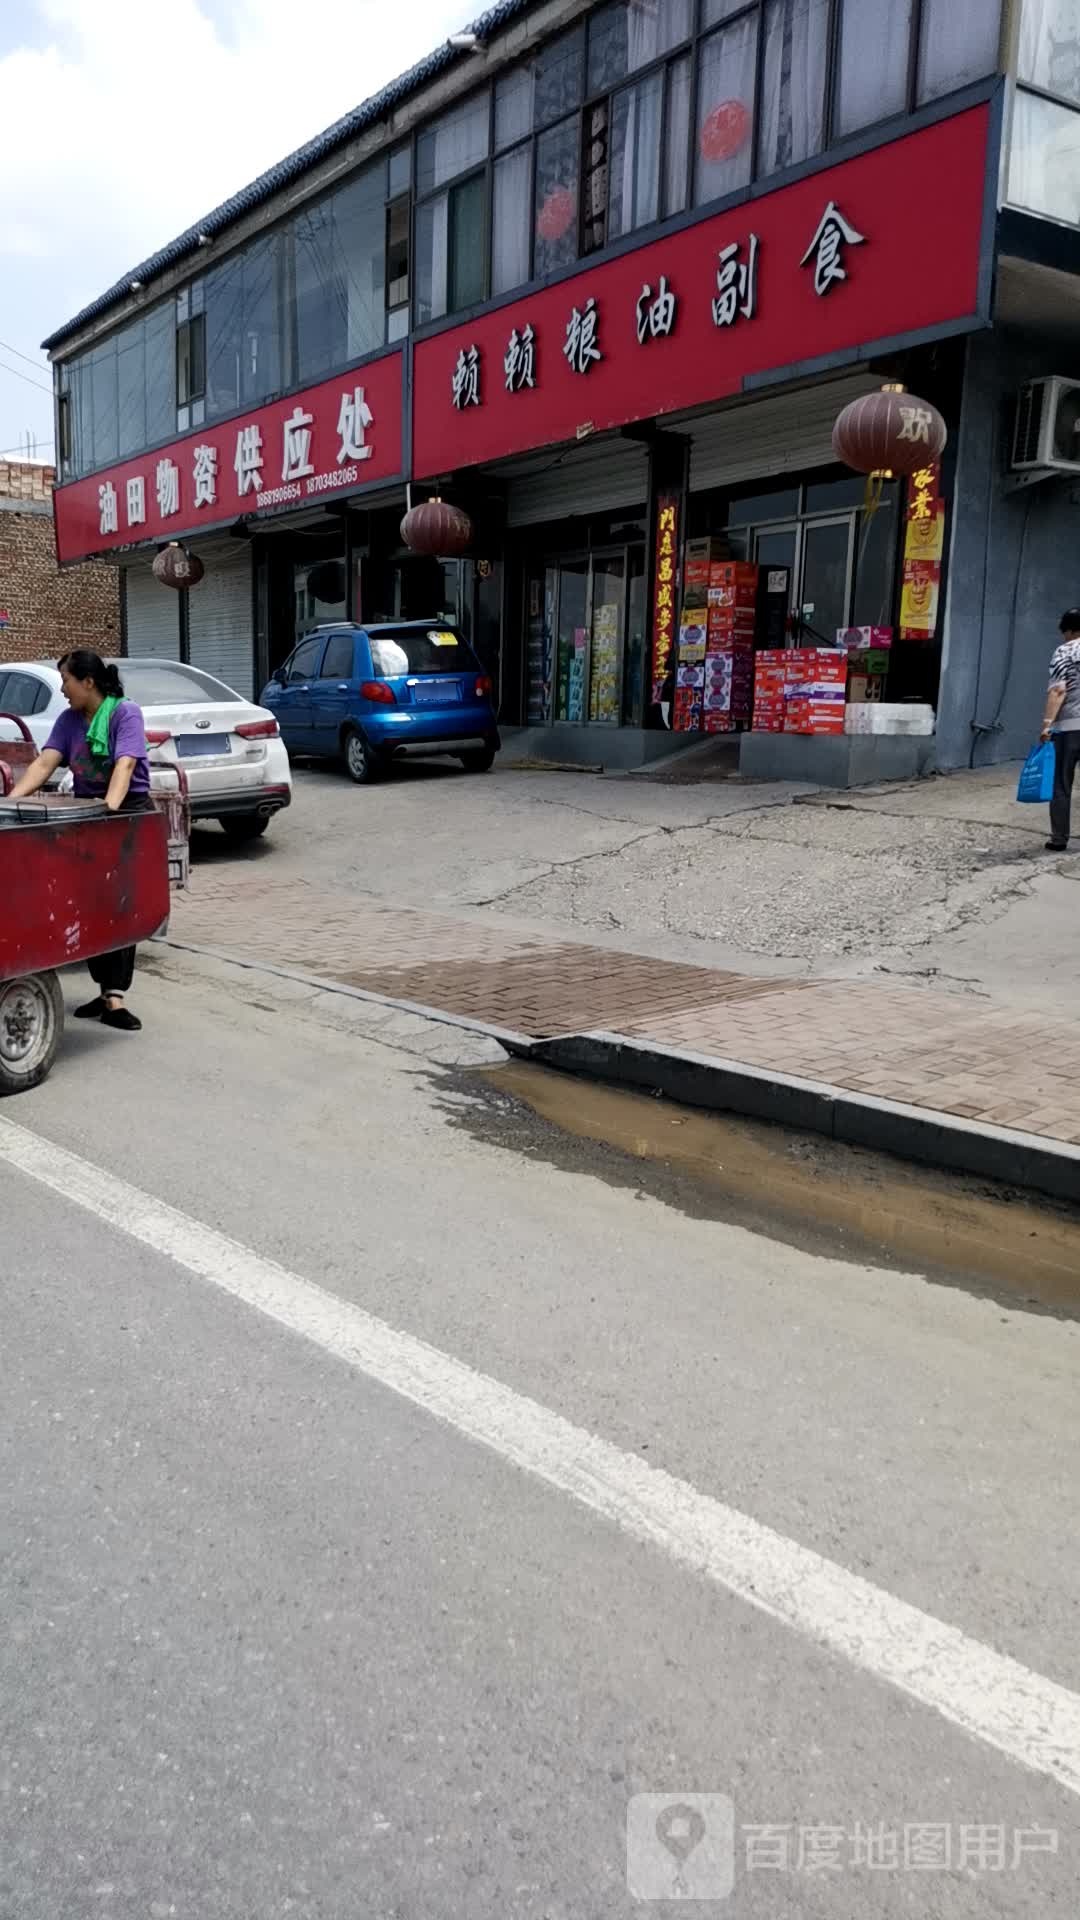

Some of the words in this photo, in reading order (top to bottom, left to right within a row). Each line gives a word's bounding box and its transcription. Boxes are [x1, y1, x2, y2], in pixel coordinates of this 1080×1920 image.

[452, 201, 865, 410] 赖赖粮油副食
[99, 386, 373, 535] 油田物资供应处
[896, 407, 933, 443] 欢
